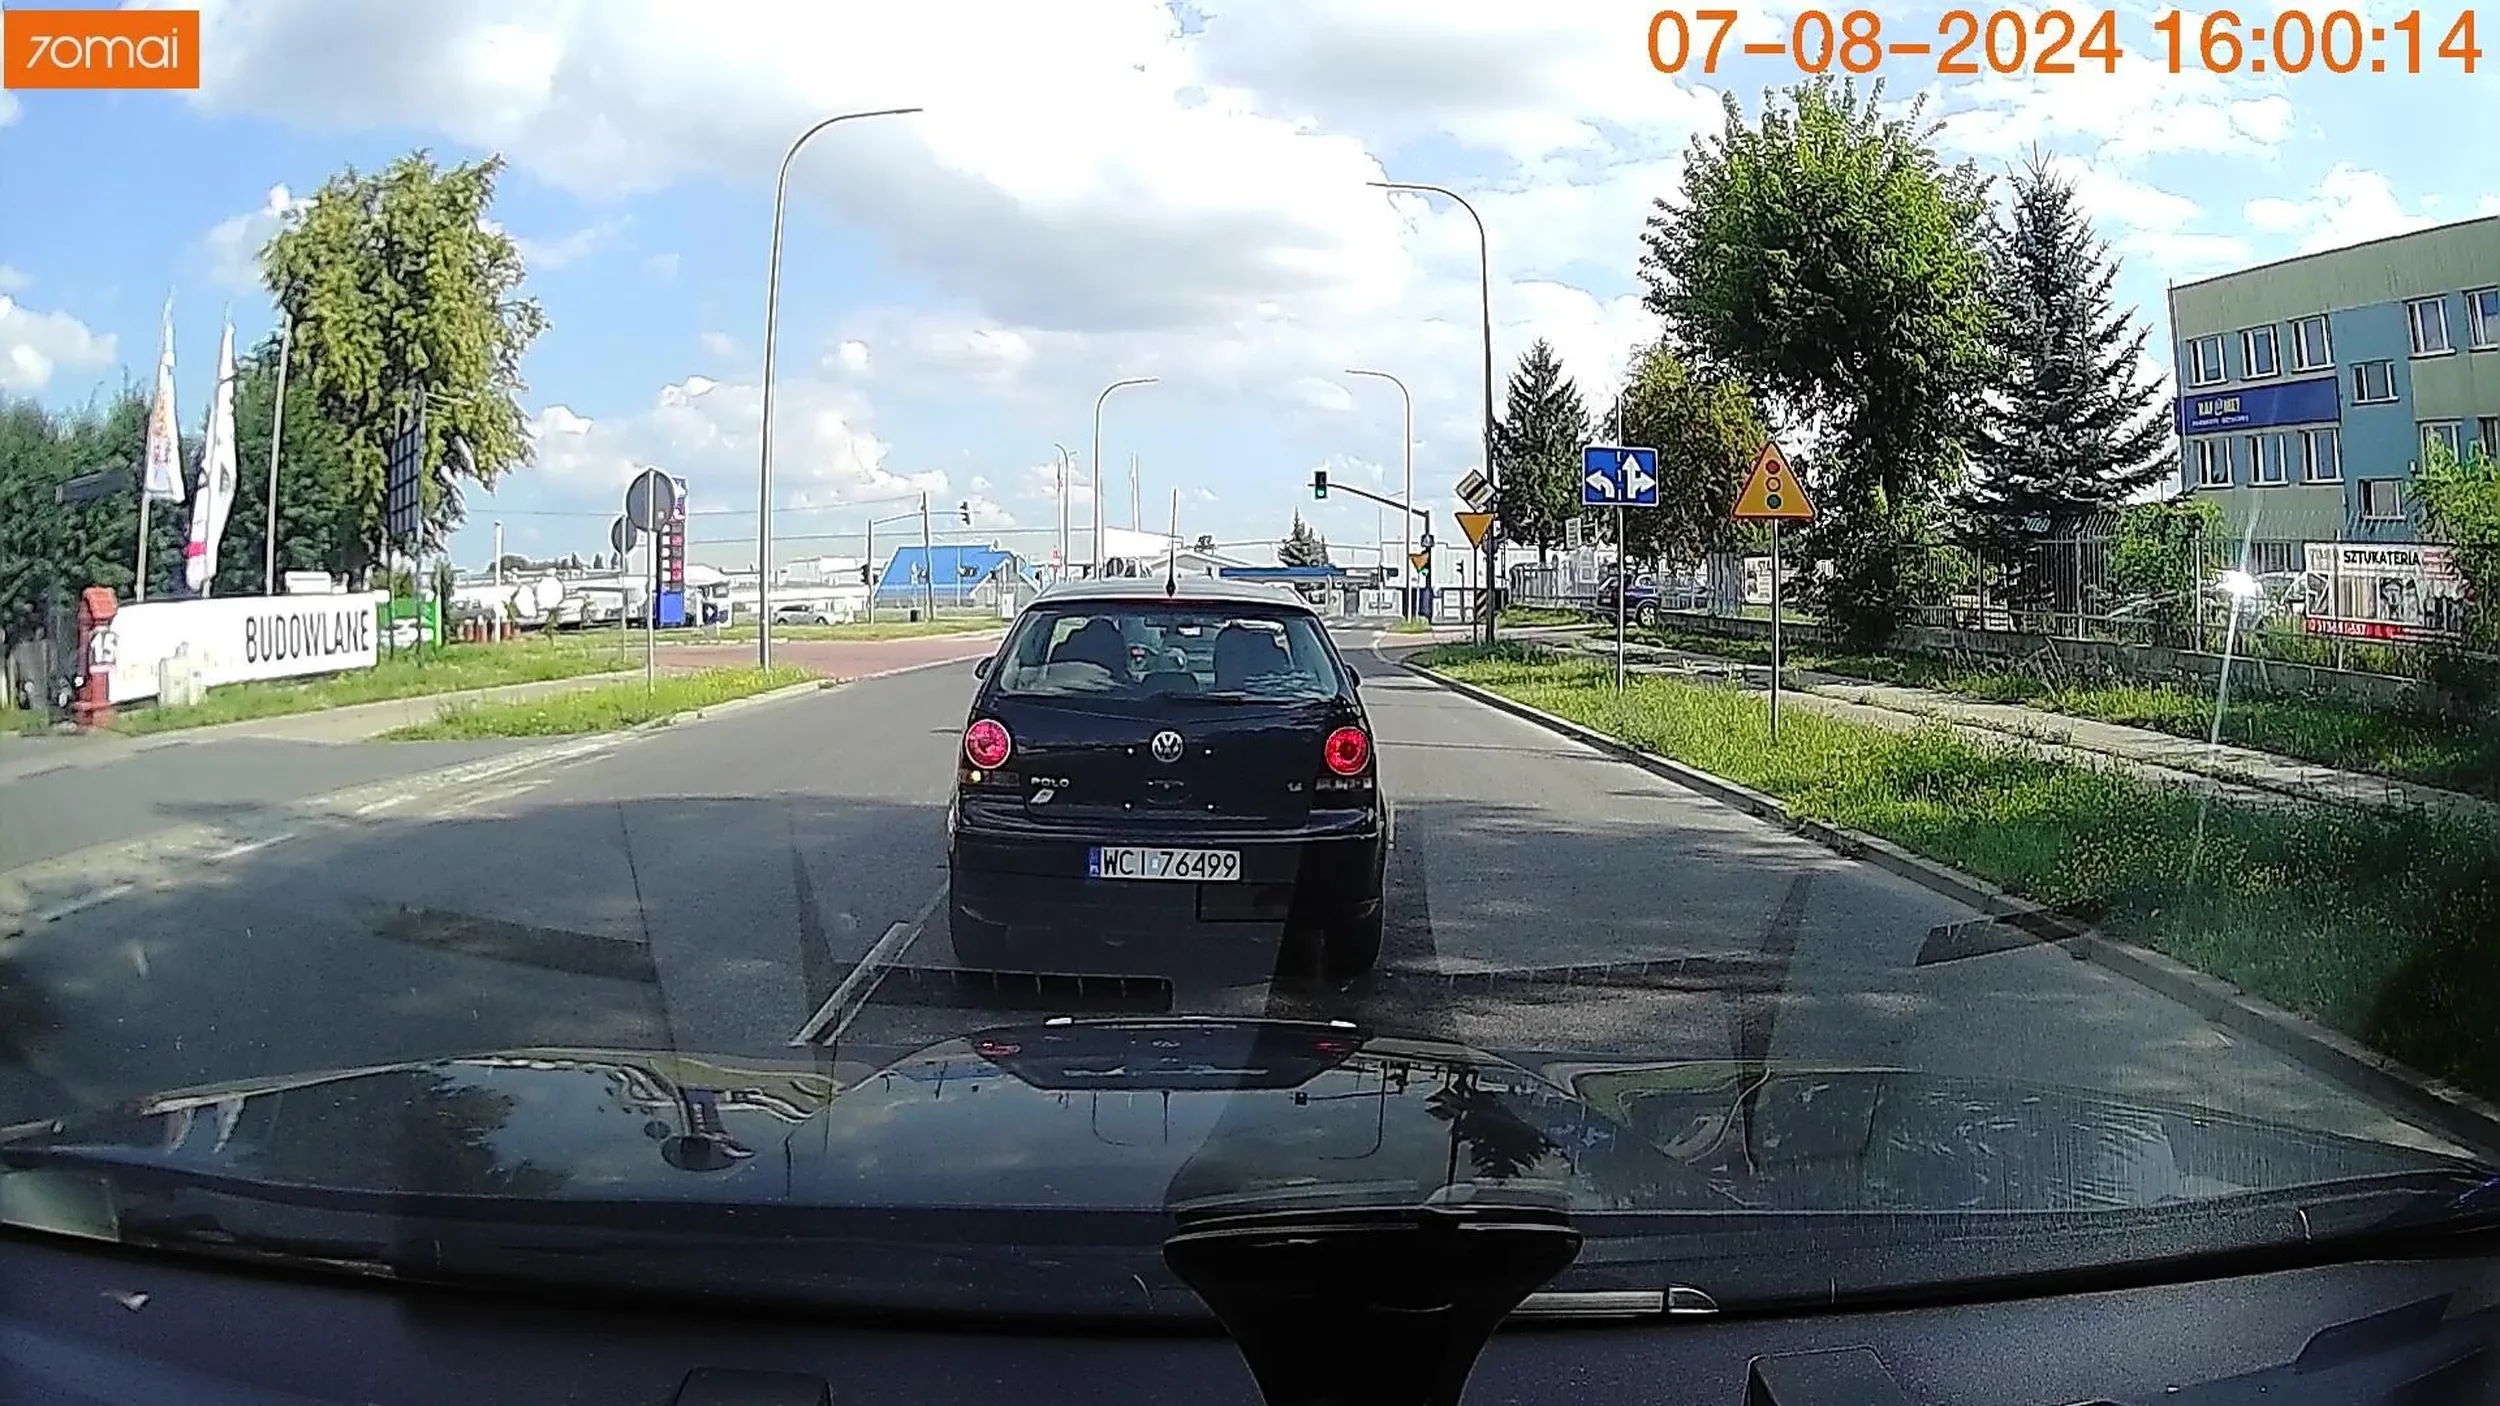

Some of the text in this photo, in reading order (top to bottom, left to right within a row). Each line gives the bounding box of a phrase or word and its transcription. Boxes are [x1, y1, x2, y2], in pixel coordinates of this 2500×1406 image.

[2343, 550, 2421, 566] SZTUKATERIA
[245, 609, 370, 664] BUDOWLANE
[1030, 776, 1070, 788] POLO
[1103, 850, 1237, 878] WCI 76499
